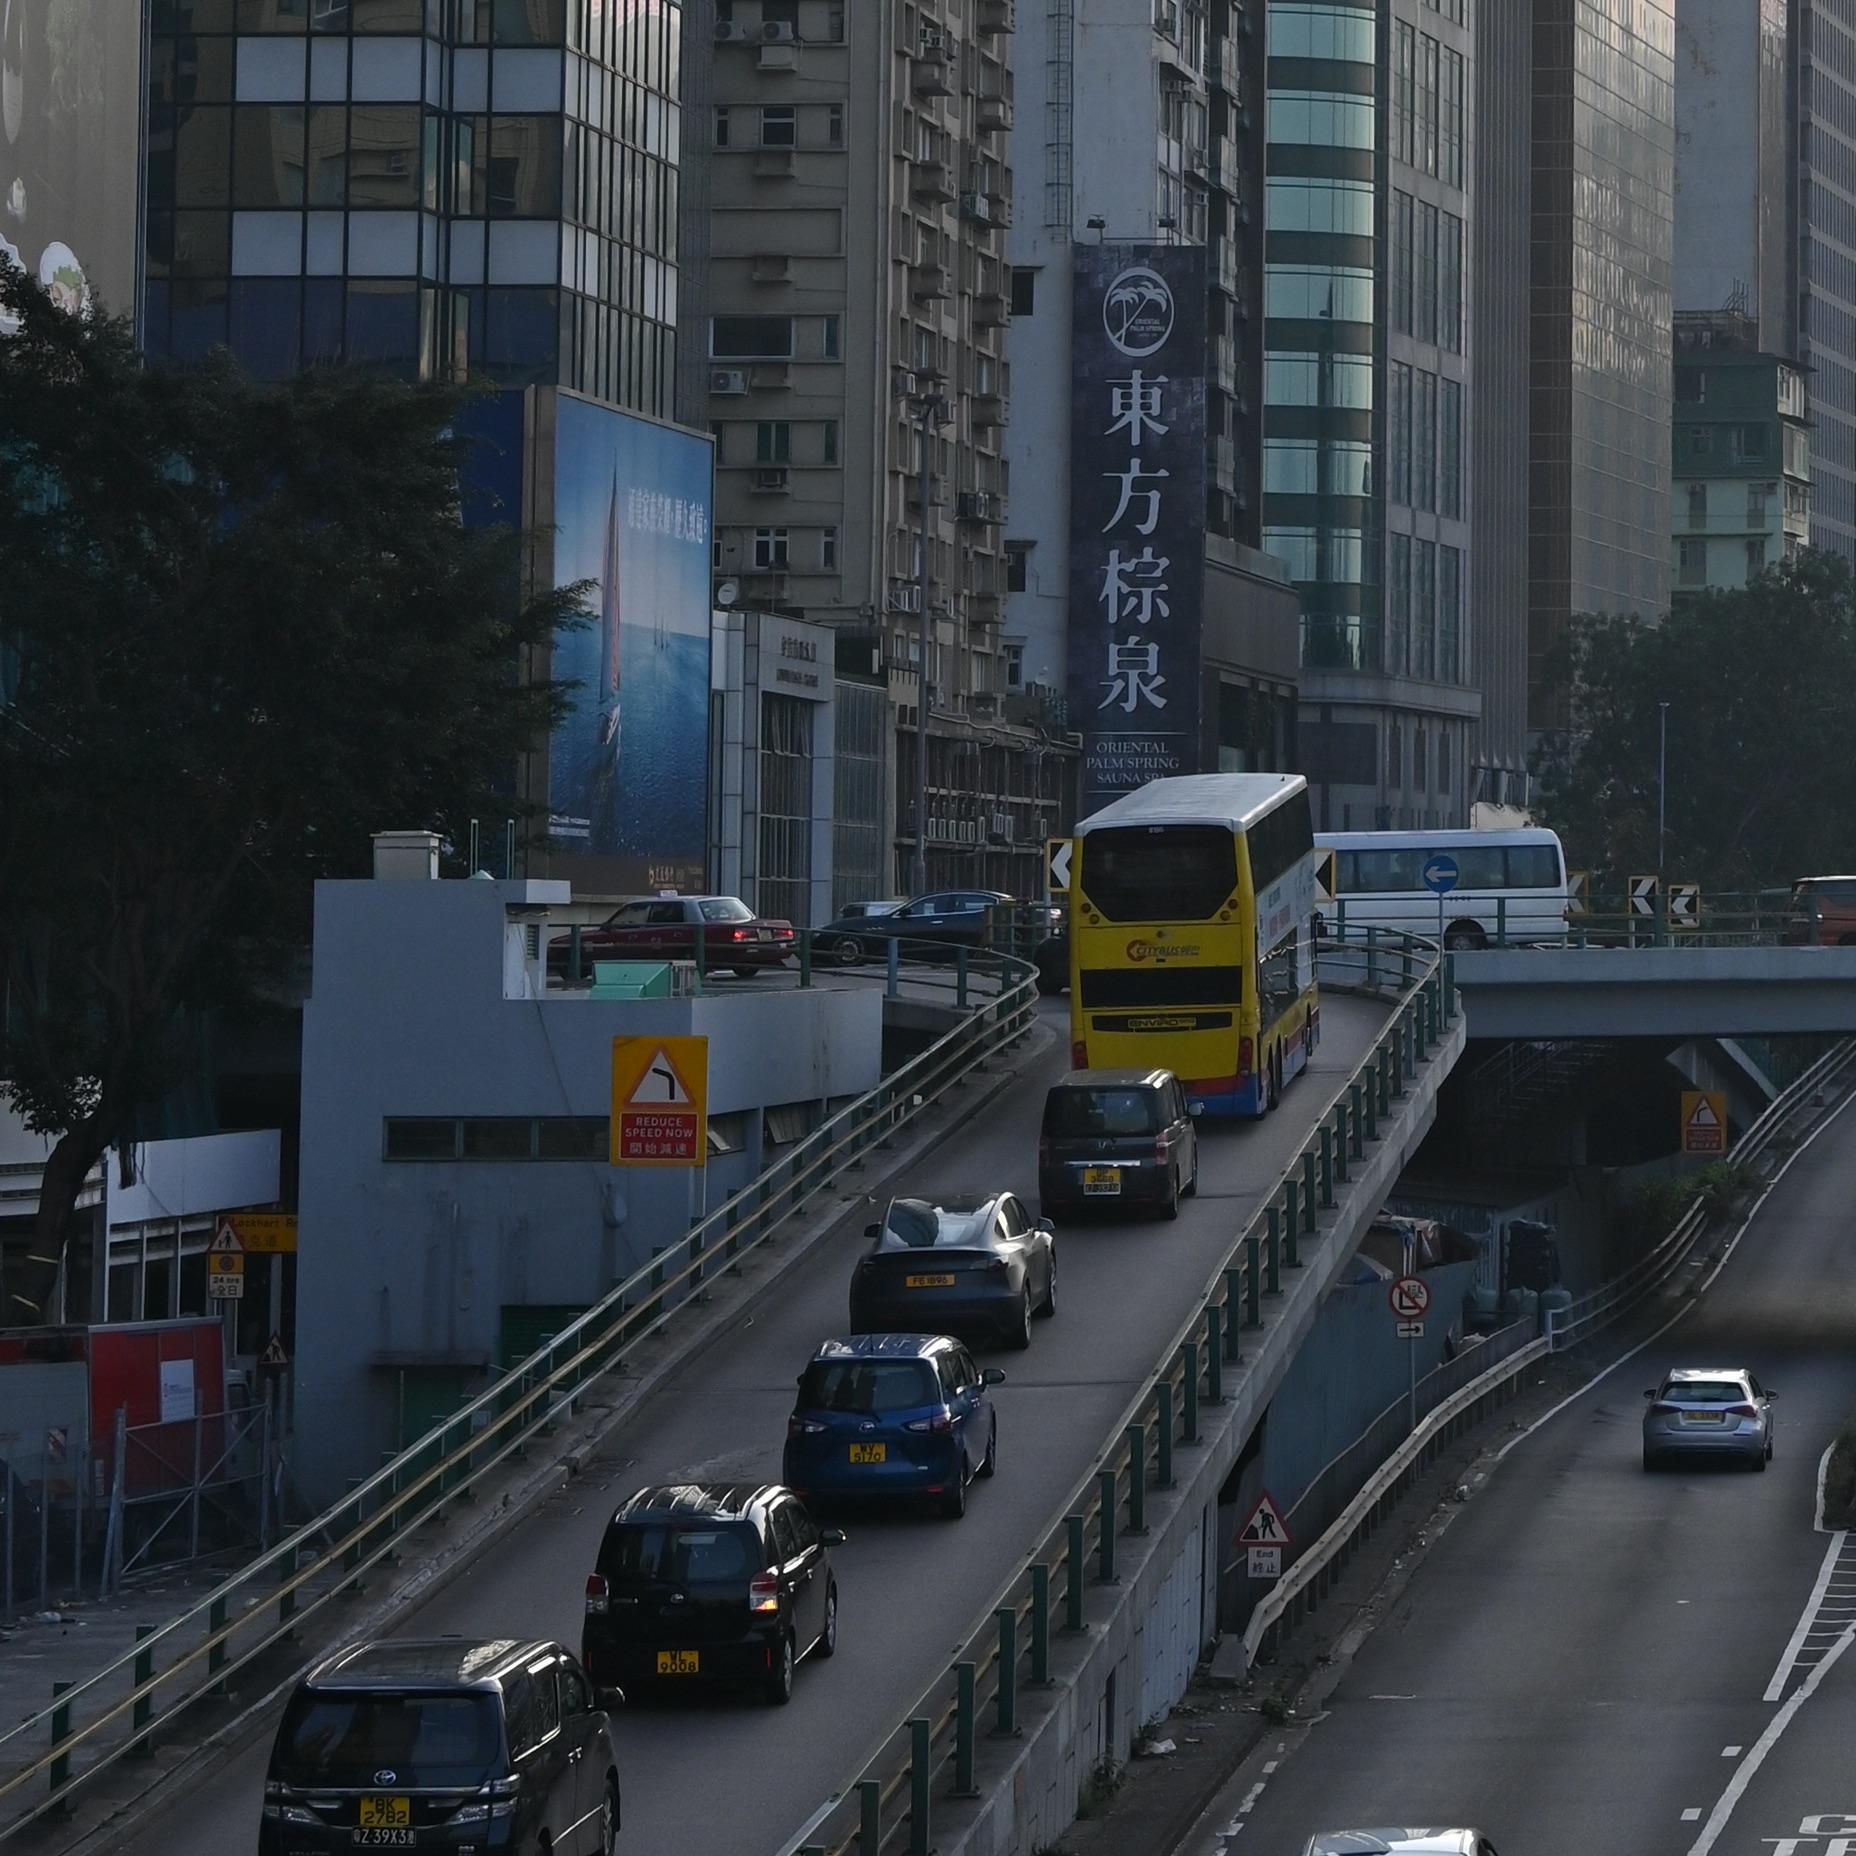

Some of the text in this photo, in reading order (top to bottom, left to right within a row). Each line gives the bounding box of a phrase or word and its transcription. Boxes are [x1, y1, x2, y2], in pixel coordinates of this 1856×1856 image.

[1099, 369, 1170, 713] 東方棕泉
[1096, 741, 1169, 753] ORIENTAL
[1087, 757, 1180, 768] PALM SPRING
[1097, 773, 1142, 784] SAUNA
[635, 1117, 685, 1127] REDUCE
[625, 1128, 693, 1138] SPEED NOW
[1256, 1549, 1274, 1559] End
[660, 1661, 697, 1673] 9008
[375, 1798, 396, 1813] BK
[364, 1811, 407, 1825] 2782
